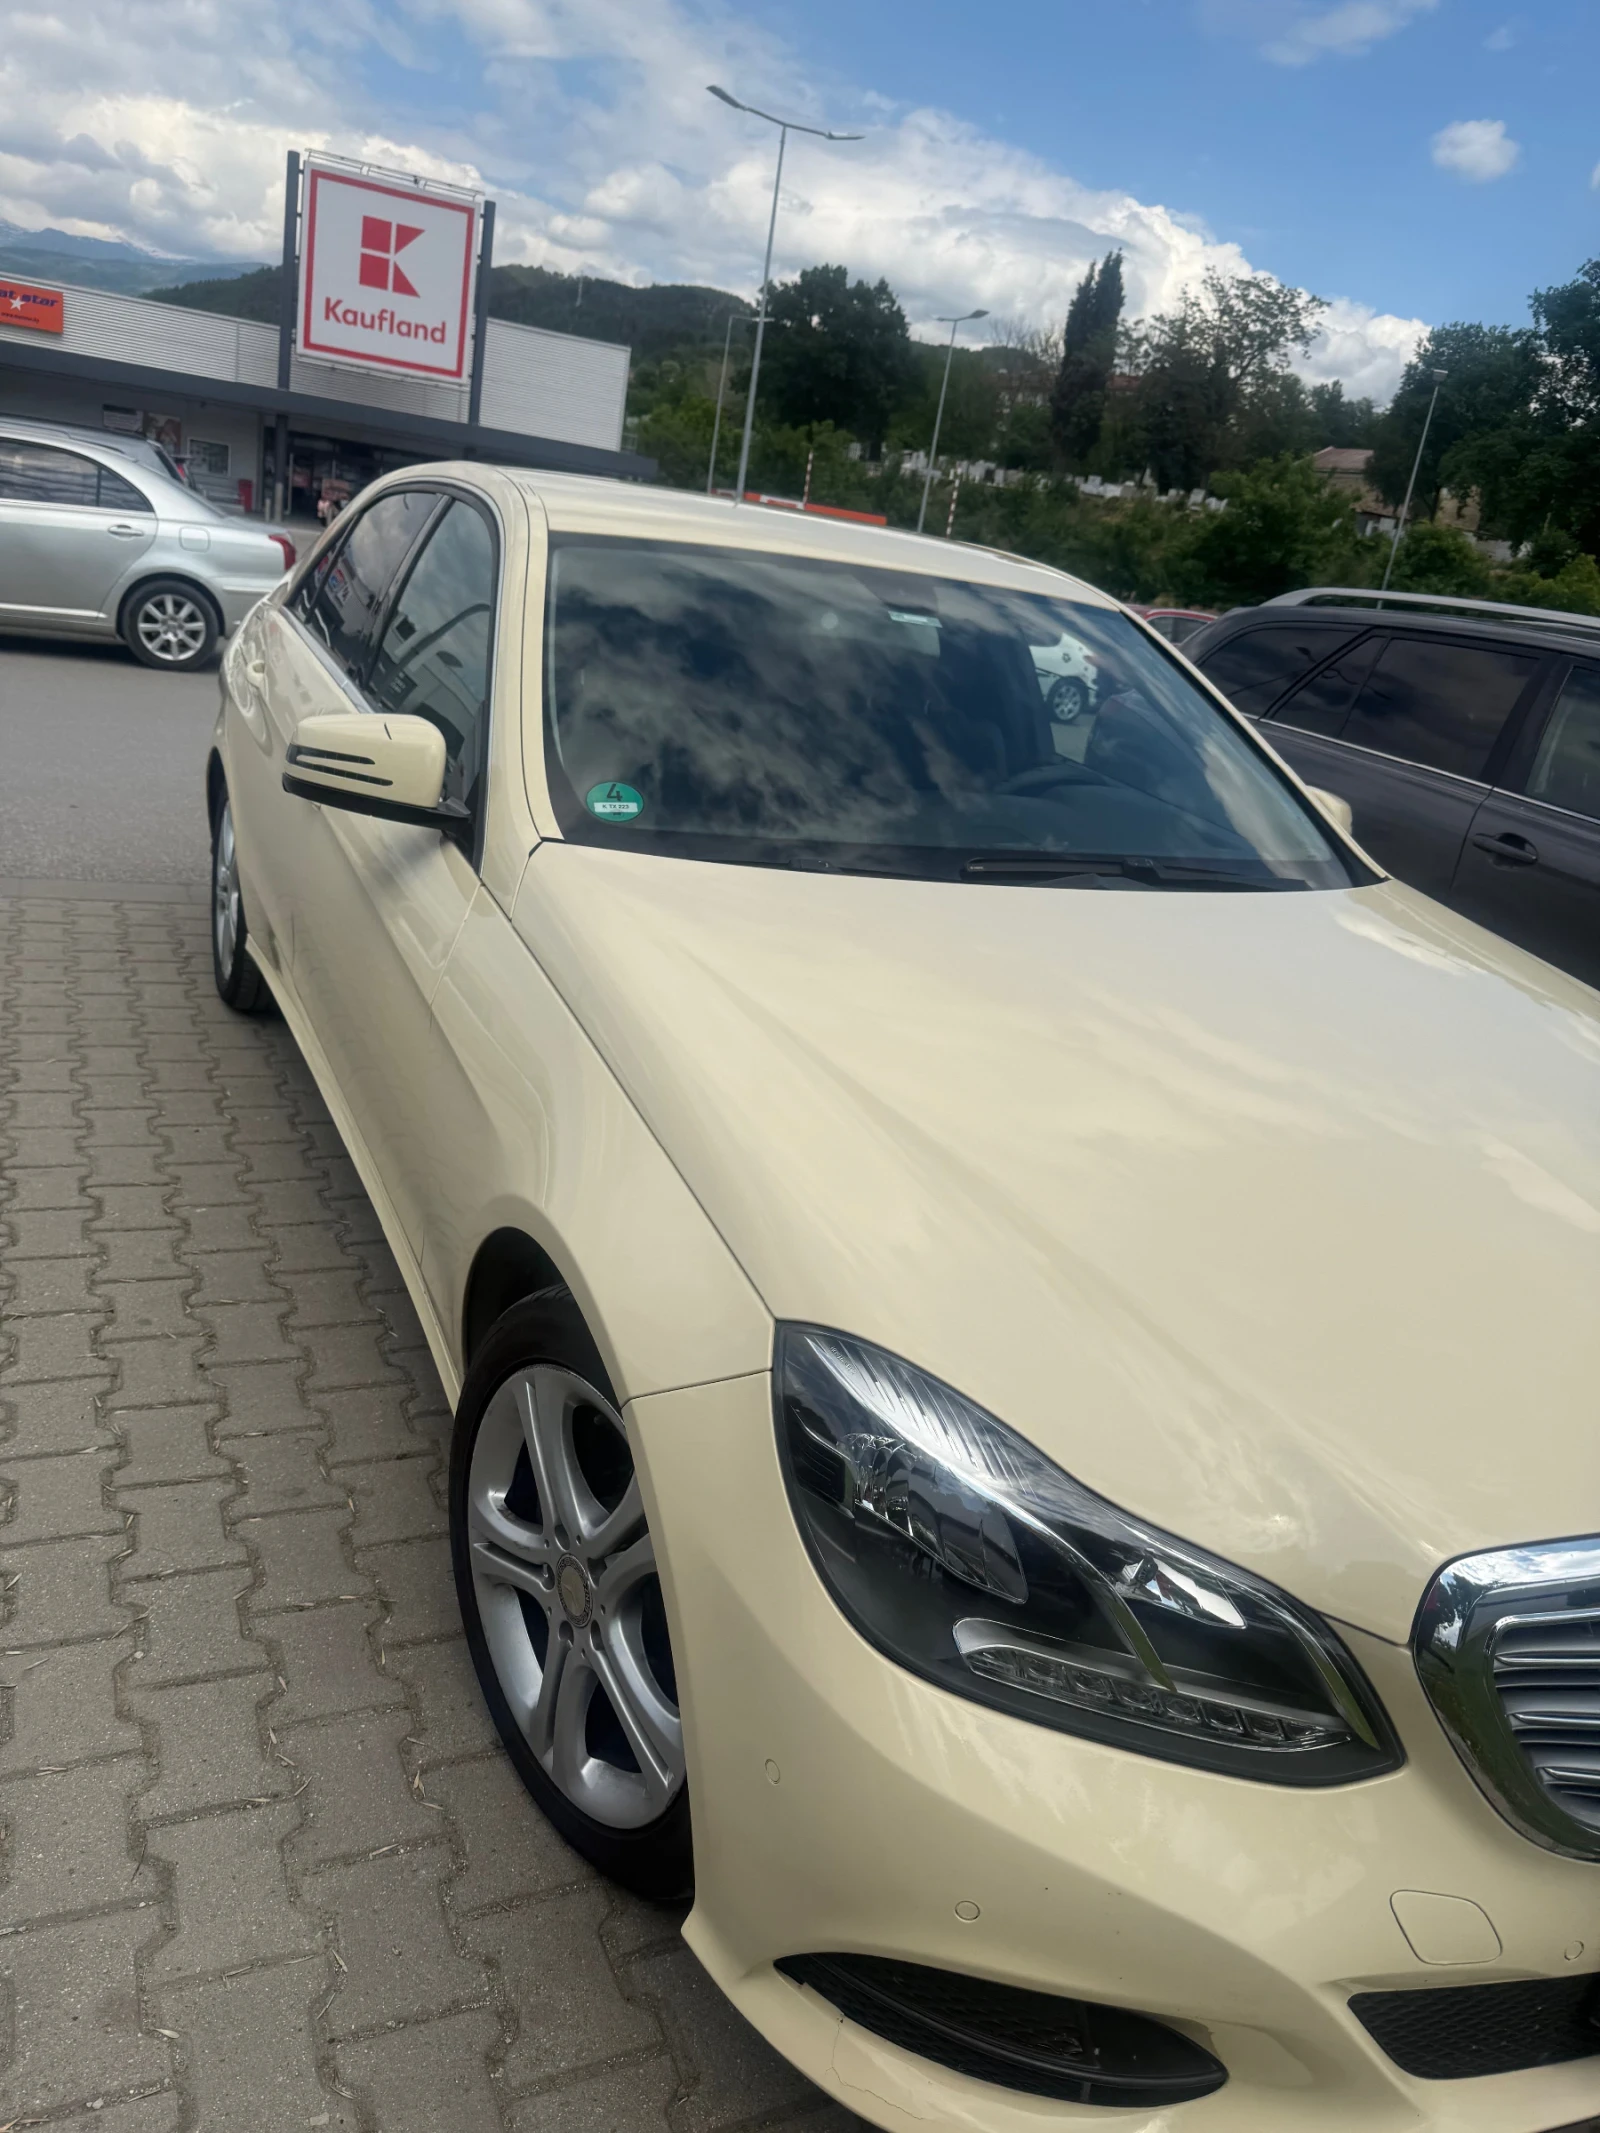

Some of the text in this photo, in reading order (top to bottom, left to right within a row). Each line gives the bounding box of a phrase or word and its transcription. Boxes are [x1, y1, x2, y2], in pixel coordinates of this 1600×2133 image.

[21, 294, 59, 307] star
[324, 296, 446, 344] Kaufland
[606, 783, 623, 801] 4
